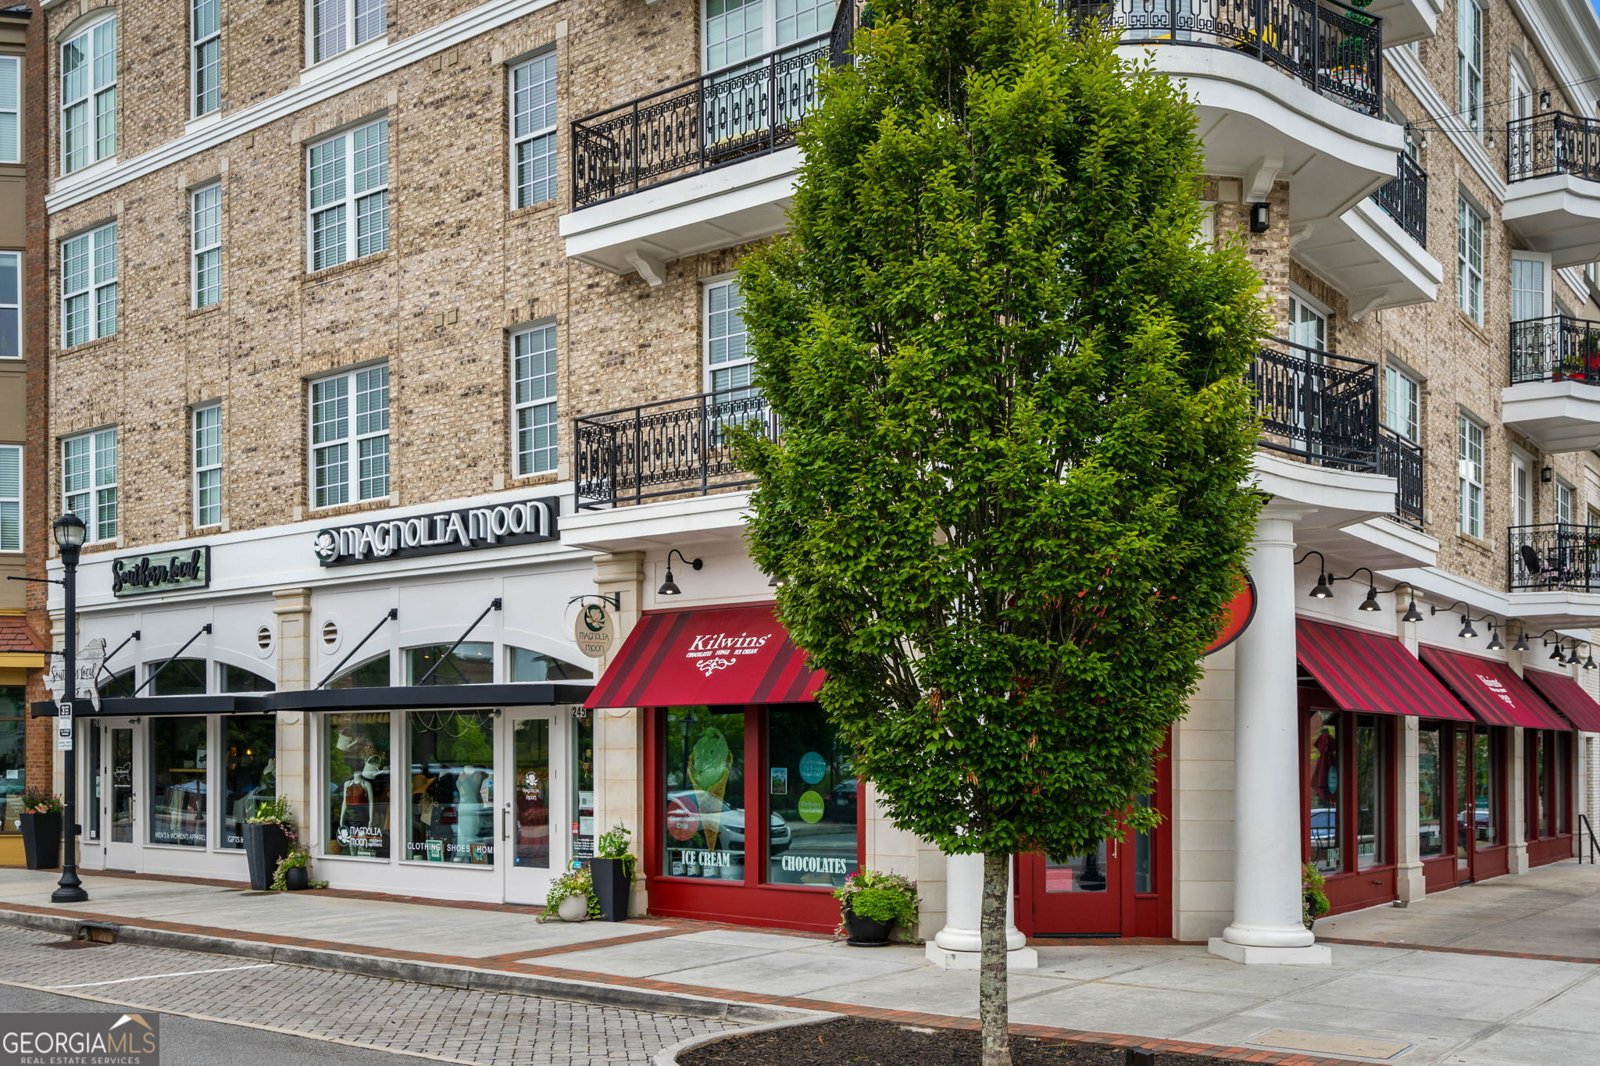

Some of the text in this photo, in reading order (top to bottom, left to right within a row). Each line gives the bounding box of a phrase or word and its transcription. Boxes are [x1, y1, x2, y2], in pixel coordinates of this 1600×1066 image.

[469, 501, 549, 543] MOON
[112, 549, 201, 592] Southern Local
[407, 842, 441, 851] CLOTHNG
[447, 843, 470, 853] SHOES
[476, 845, 493, 854] HOM
[681, 850, 731, 868] ICE CREAM
[781, 855, 847, 874] CHOCOLATES
